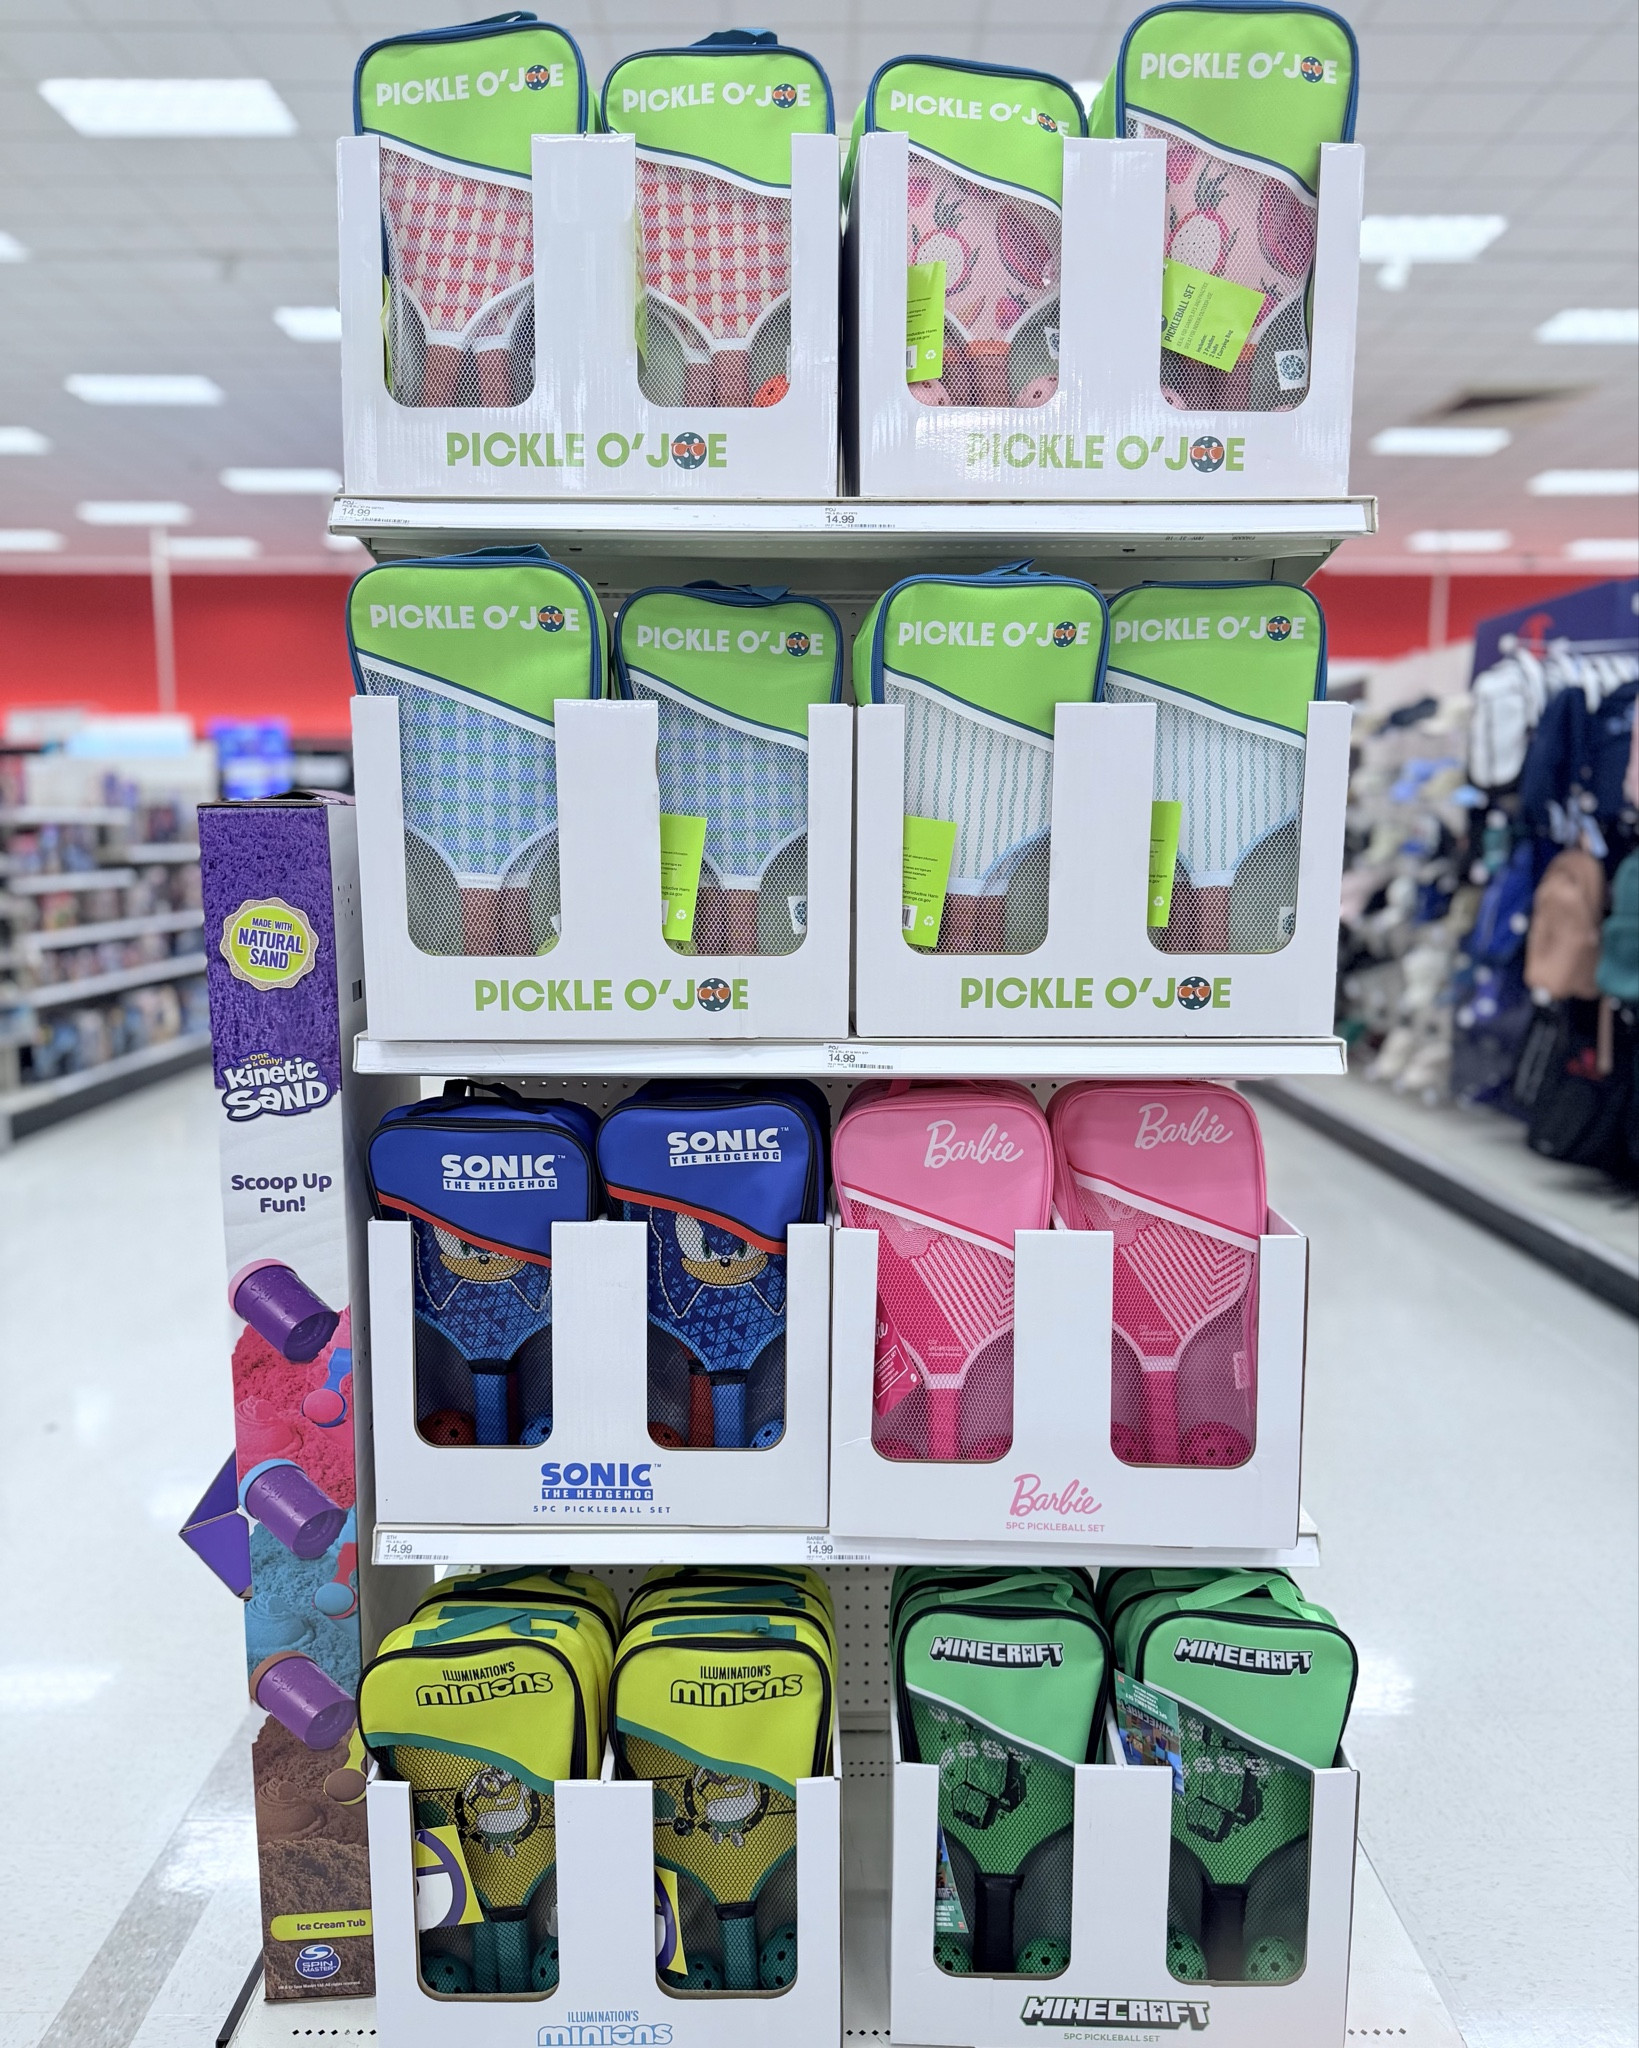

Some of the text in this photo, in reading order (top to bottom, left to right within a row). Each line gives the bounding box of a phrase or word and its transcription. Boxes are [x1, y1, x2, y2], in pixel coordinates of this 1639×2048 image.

[1141, 52, 1239, 80] PICKLE
[376, 75, 469, 106] PICKLE
[623, 82, 714, 113] PICKLE
[890, 90, 982, 121] PICKLE
[1163, 284, 1196, 342] PICKLEBALL SET
[447, 431, 728, 470] PICKLE O'JOE
[967, 432, 1245, 473] PICKLE O'JOE
[342, 508, 370, 516] 14.99
[826, 515, 854, 523] 14.99
[370, 605, 475, 629] PICKLE
[637, 624, 730, 652] PICKLE
[898, 620, 994, 648] PICKLE
[1115, 617, 1210, 643] PICKLE
[252, 918, 293, 931] MADE WITH
[238, 928, 304, 954] NATURAL
[250, 948, 290, 970] SAND
[475, 977, 748, 1012] PICKLE O'JOE
[961, 976, 1232, 1010] PICKLE O'JOE
[259, 1057, 283, 1065] Only!
[829, 1054, 855, 1062] 14.99
[1135, 1102, 1234, 1150] Barbie
[667, 1128, 780, 1154] SONIC
[924, 1119, 1024, 1168] Barbie
[441, 1154, 556, 1178] SONIC
[670, 1150, 781, 1166] THE HEDGEHOG
[232, 1172, 332, 1194] Scoop Up
[444, 1179, 558, 1190] THE HEDGEHOG
[260, 1196, 306, 1213] Fun!
[541, 1462, 652, 1487] SONIC
[544, 1489, 653, 1500] THE HEDGEHOG
[1010, 1473, 1102, 1516] Barbie
[1006, 1522, 1105, 1532] 5PC PICKLEBALL SET
[386, 1544, 412, 1553] 14.99
[808, 1545, 833, 1554] 14.99
[930, 1636, 1064, 1668] MINECRAFT
[1174, 1638, 1313, 1676] MINECRAFT
[442, 1662, 516, 1682] ILLUMINATION'S
[700, 1664, 771, 1679] ILLUMINATION'S
[297, 1918, 366, 1931] Ice Cream Tub
[568, 2010, 639, 2022] ILLUMINATION'S
[1020, 1996, 1210, 2030] MINECRAFT
[1085, 2033, 1140, 2041] PICKLEBALL
[1143, 2034, 1160, 2042] SET
